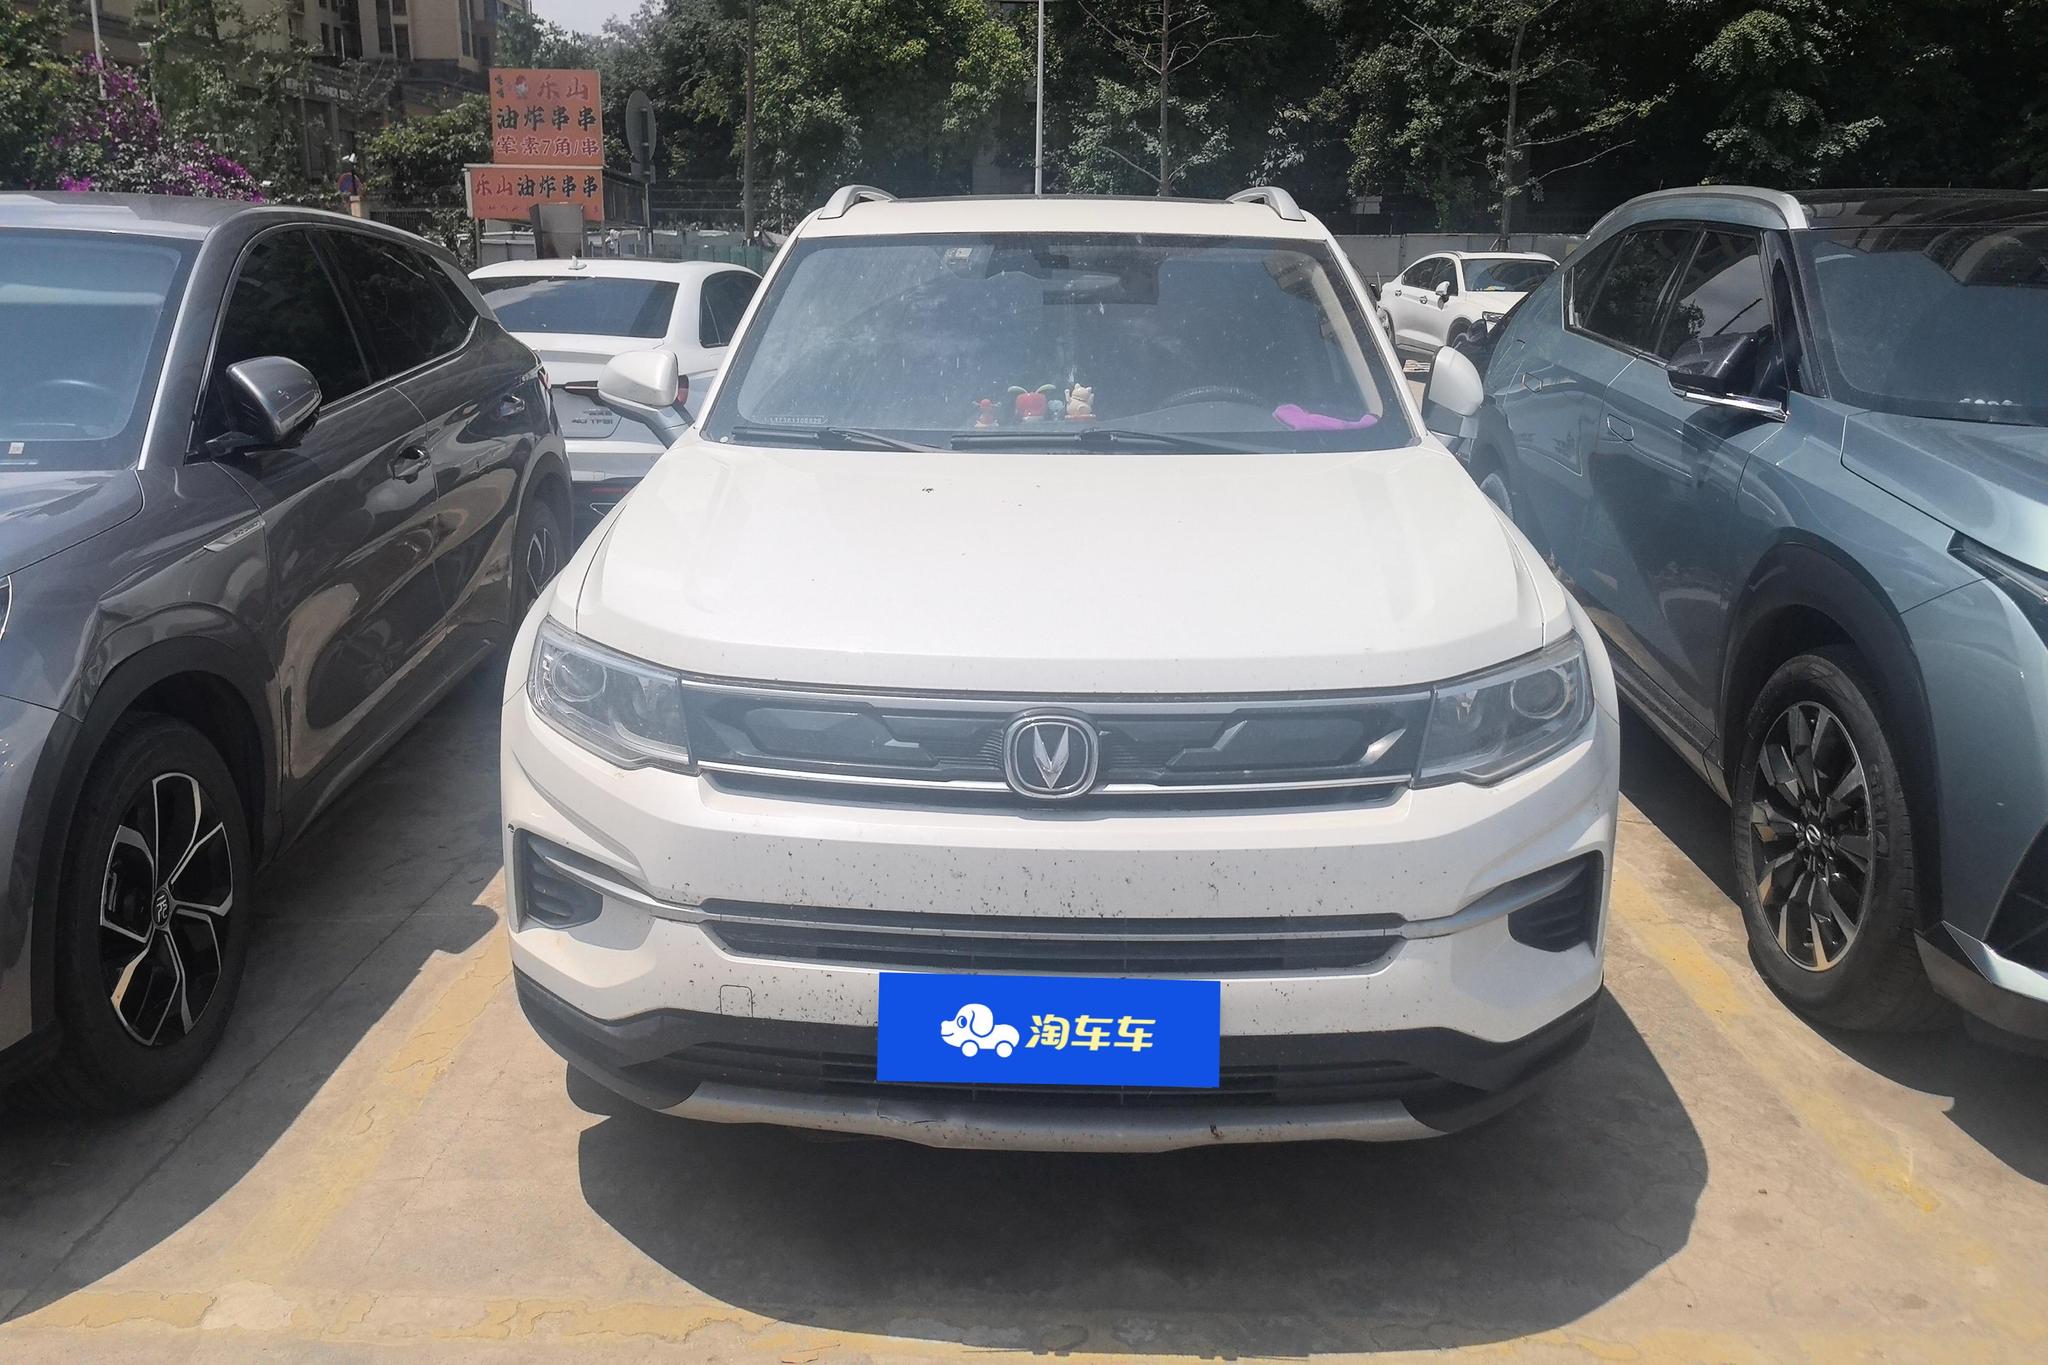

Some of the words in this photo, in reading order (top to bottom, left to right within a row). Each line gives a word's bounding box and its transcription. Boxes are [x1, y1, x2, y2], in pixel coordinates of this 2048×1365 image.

[537, 75, 588, 100] 乐山
[497, 105, 596, 131] 油炸串串
[497, 136, 599, 156] 荤素7角/串
[475, 174, 598, 198] 乐山油炸串串
